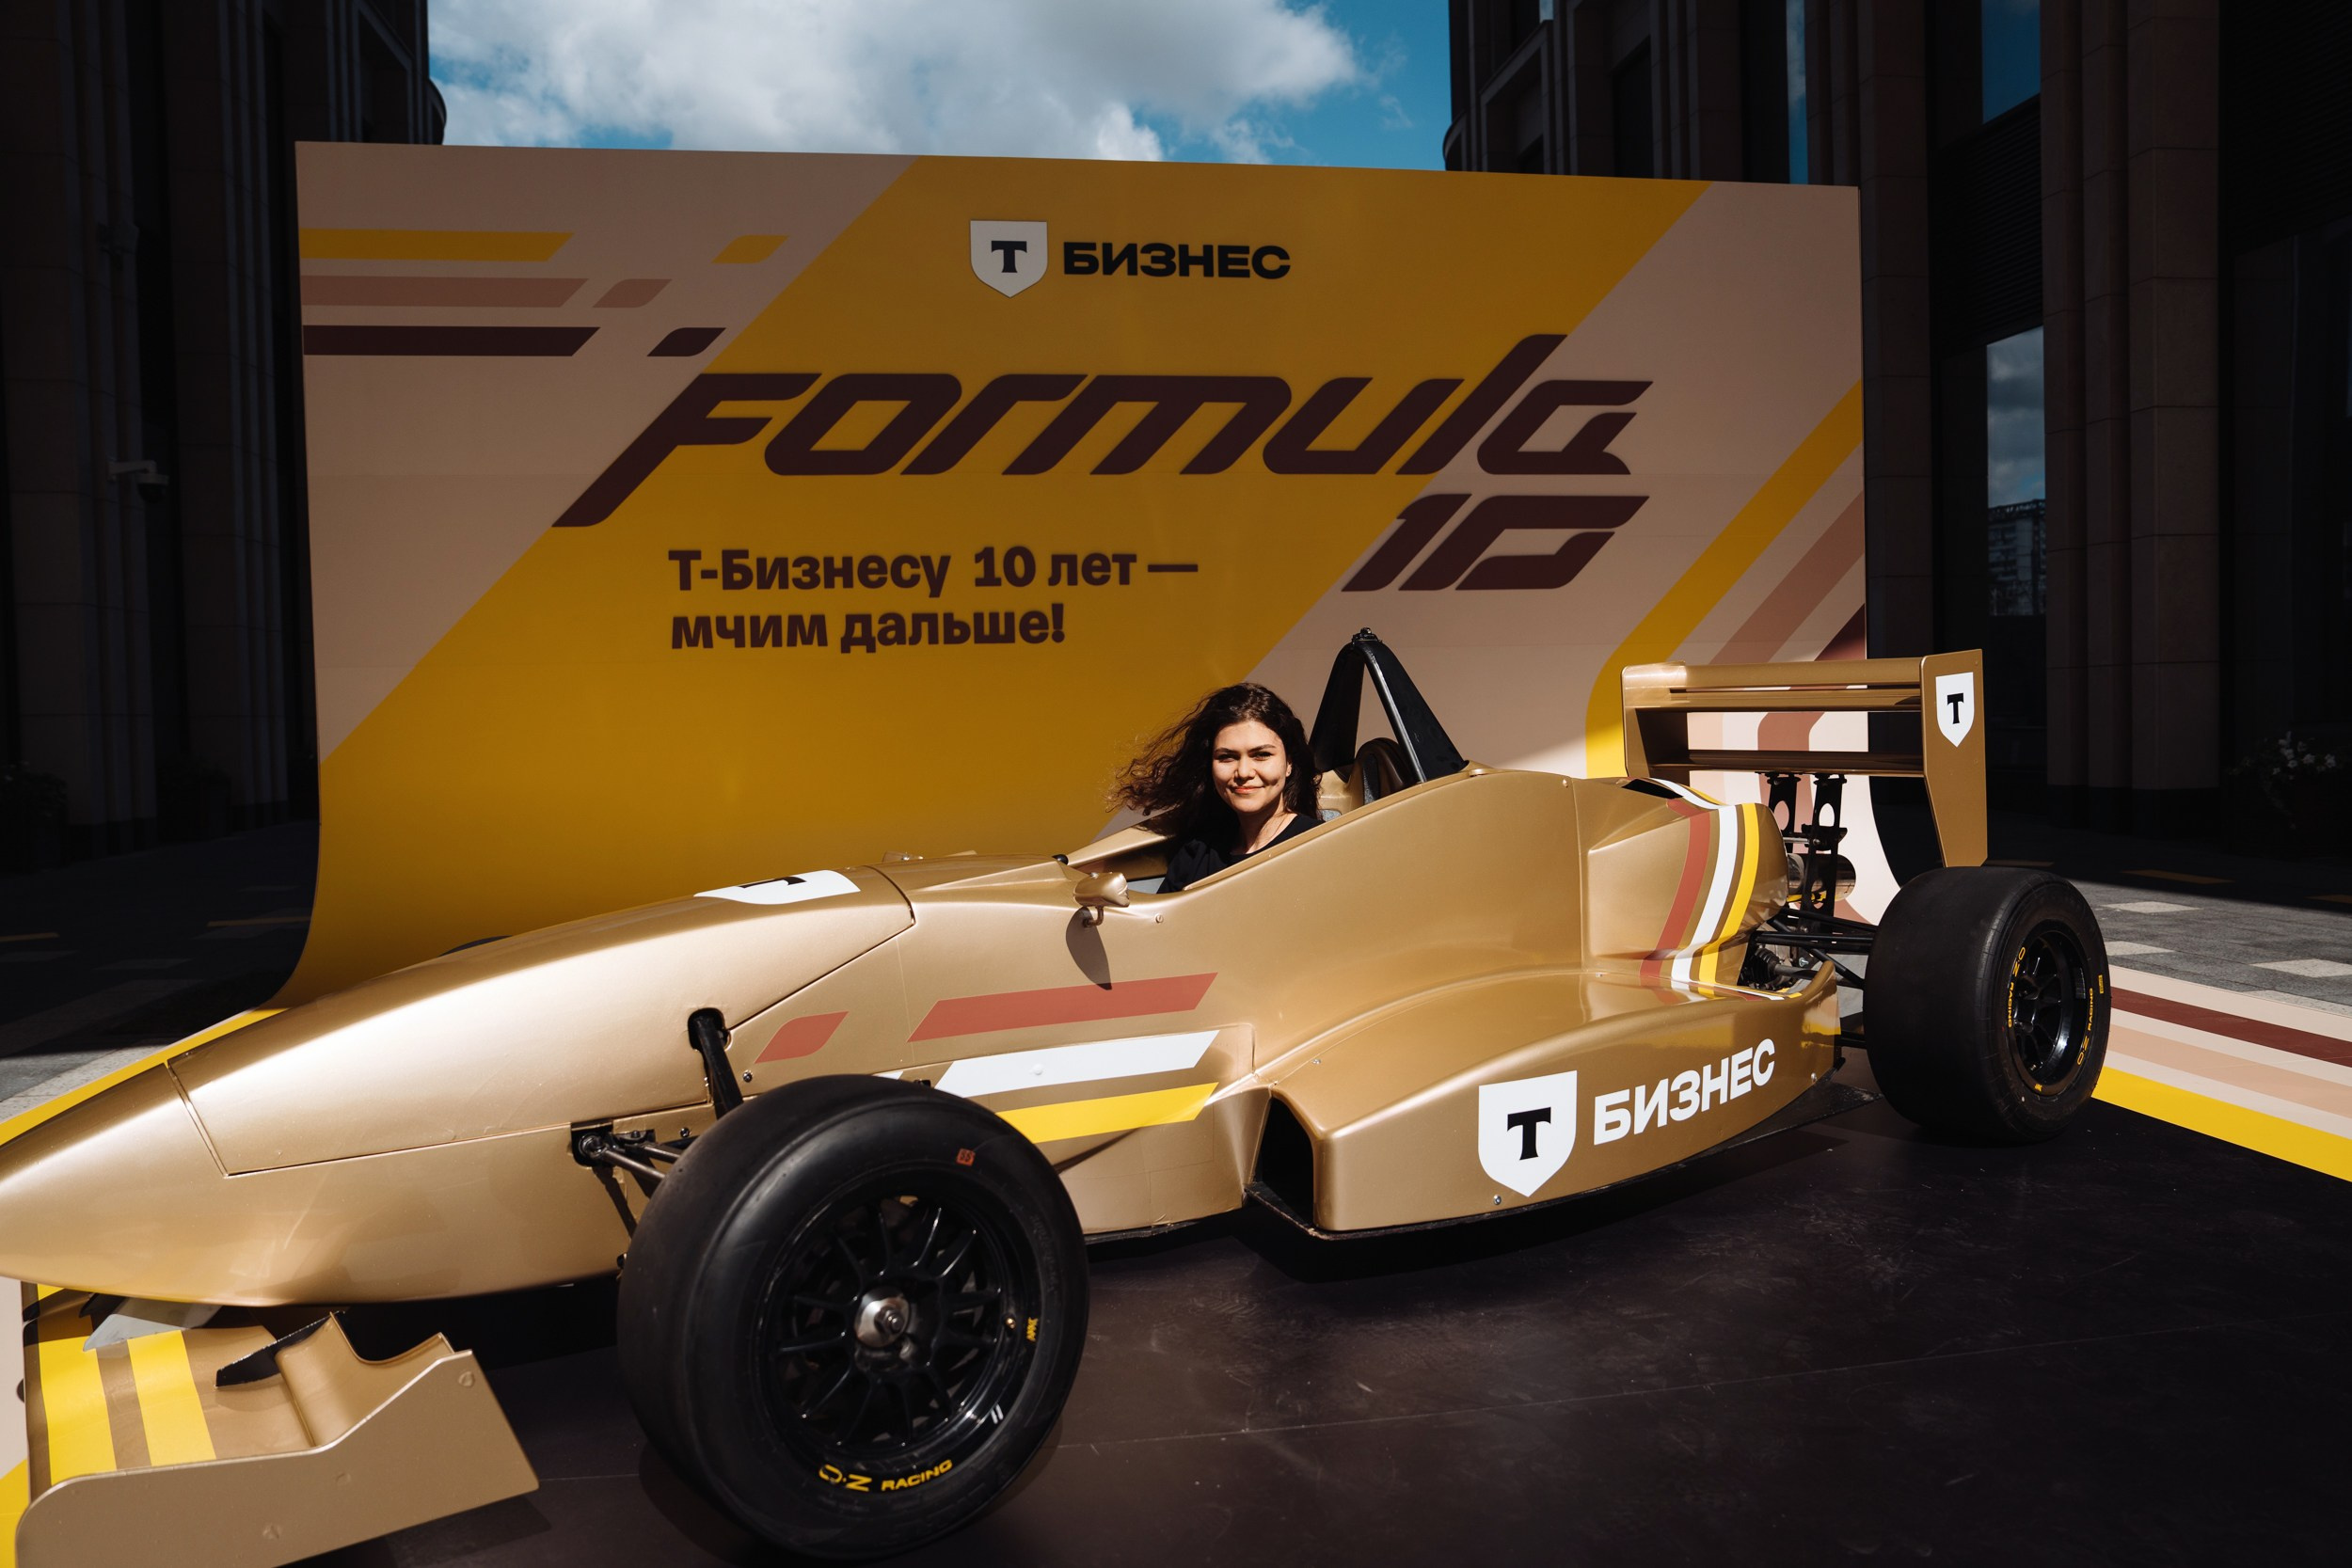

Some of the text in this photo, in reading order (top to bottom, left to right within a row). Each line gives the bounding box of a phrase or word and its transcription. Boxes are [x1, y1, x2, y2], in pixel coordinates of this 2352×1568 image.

[991, 240, 1291, 279] Т БИЗНЕС
[551, 334, 1654, 528] Formula
[1341, 493, 1650, 593] 10
[668, 548, 951, 598] Т-Бизнесу
[974, 546, 1037, 588] 10
[1047, 551, 1137, 587] лет
[671, 603, 1066, 654] мчим дальше!
[1947, 692, 1964, 725] Т
[1506, 1037, 1776, 1161] Т БИЗНЕС
[881, 1459, 954, 1492] RACING
